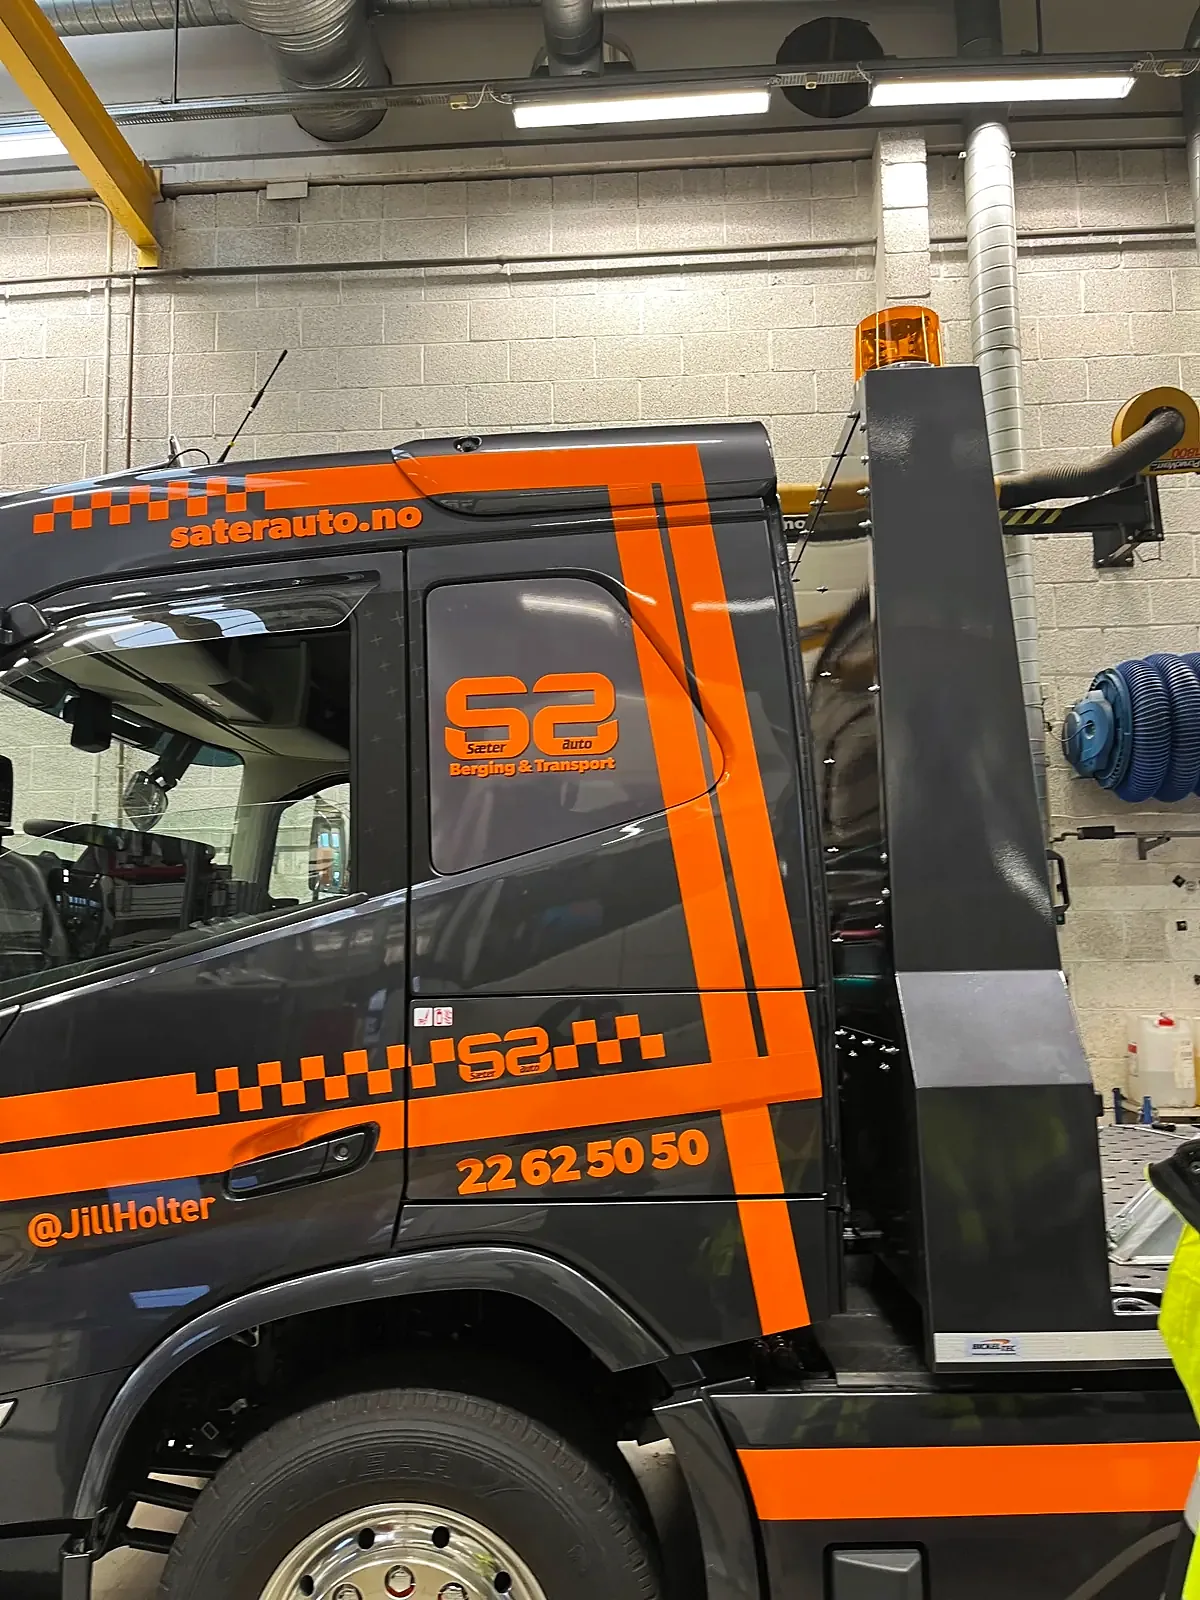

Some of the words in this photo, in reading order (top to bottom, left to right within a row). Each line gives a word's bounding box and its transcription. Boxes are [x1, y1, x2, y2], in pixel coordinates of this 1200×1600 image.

[170, 506, 422, 548] saterauto.no
[450, 760, 517, 778] Berging
[518, 760, 533, 773] &
[534, 757, 616, 773] Transport
[466, 742, 507, 754] Sæter
[562, 739, 593, 750] auto
[456, 1154, 517, 1195] 22
[520, 1145, 582, 1186] 62
[586, 1137, 645, 1178] 50
[651, 1129, 710, 1170] 50
[27, 1196, 216, 1248] @JillHolter
